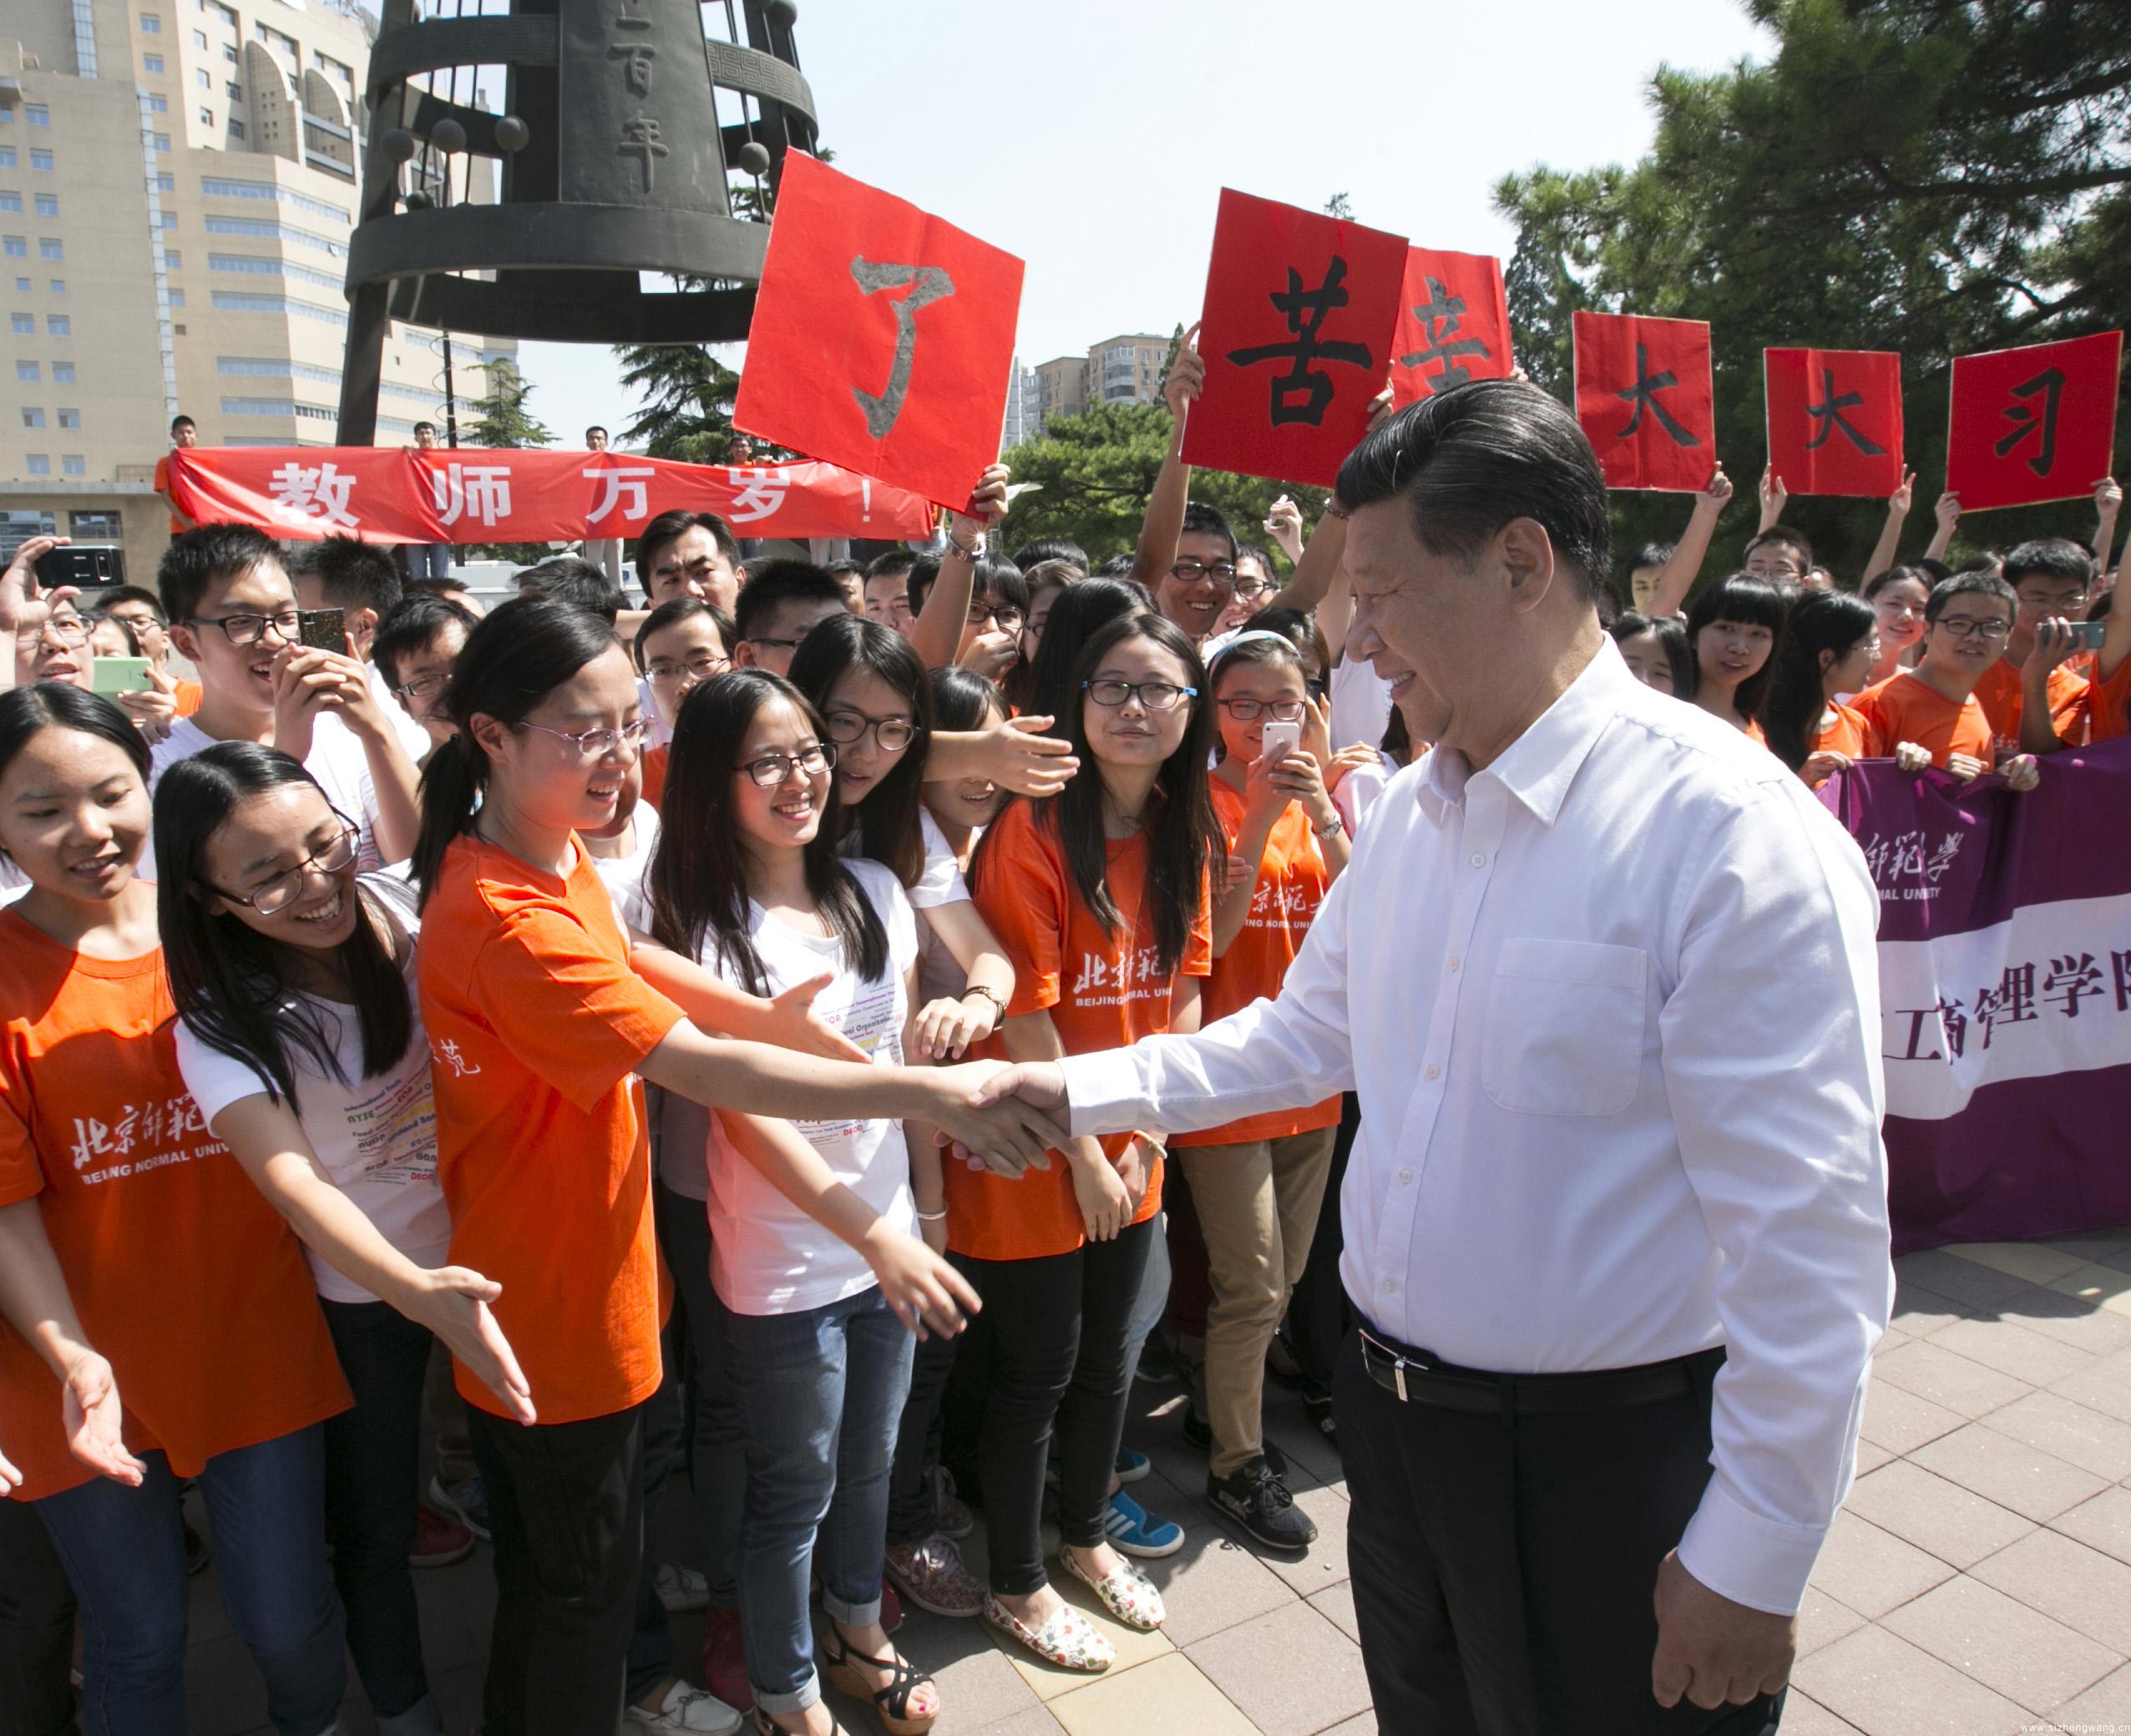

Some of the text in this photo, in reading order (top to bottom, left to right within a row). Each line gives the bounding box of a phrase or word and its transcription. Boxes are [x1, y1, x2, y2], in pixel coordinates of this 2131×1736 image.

[850, 255, 956, 439] 了
[1225, 255, 1373, 428] 苦
[1401, 276, 1491, 392] 辛
[1617, 342, 1701, 448] 大
[1805, 369, 1886, 456] 大
[1995, 367, 2067, 478] 习
[135, 1150, 190, 1173] NORMAL
